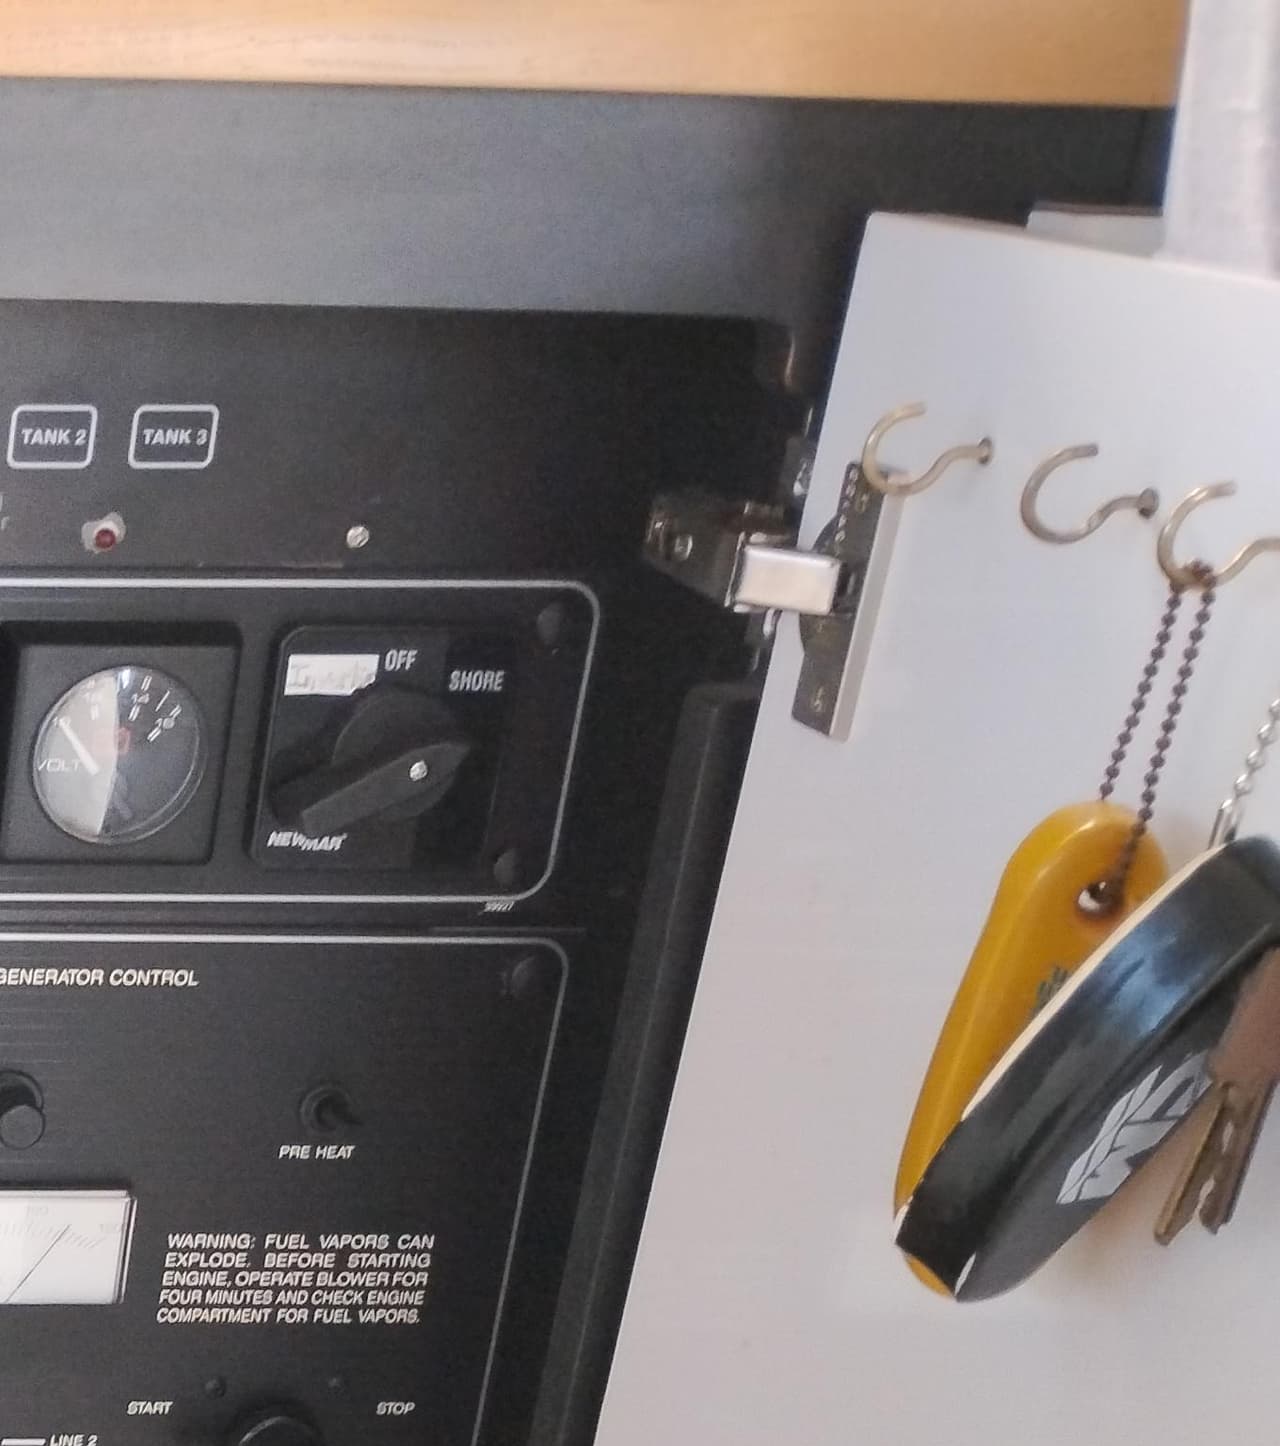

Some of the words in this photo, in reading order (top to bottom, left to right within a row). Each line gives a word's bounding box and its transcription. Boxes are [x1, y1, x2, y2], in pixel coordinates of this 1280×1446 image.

[23, 428, 70, 445] TANK
[74, 428, 88, 446] 2
[143, 428, 190, 445] TANK
[196, 429, 209, 447] 3
[385, 650, 417, 671] OFF
[449, 670, 504, 691] SHORE
[267, 830, 342, 852] NEWMAR
[110, 969, 198, 986] CONTROL
[279, 1145, 311, 1159] PRE
[316, 1146, 355, 1159] HEAT
[168, 1234, 255, 1249] WARNING:
[265, 1234, 309, 1249] FUEL
[320, 1235, 389, 1249] VAPORS
[398, 1234, 434, 1249] CAN
[165, 1252, 250, 1267] EXPLODE.
[264, 1253, 335, 1268] BEFORE
[347, 1253, 430, 1268] STARTING
[163, 1271, 231, 1287] ENGINE,
[235, 1271, 314, 1286] OPERATE
[316, 1272, 389, 1286] BLOWER
[392, 1272, 428, 1286] FOR
[159, 1289, 202, 1304] FOUR
[205, 1290, 273, 1305] MINUTES
[275, 1290, 308, 1305] AND
[311, 1290, 364, 1305] CHECK
[367, 1290, 425, 1305] ENGINE
[157, 1308, 272, 1323] COMPARTMENT
[277, 1308, 308, 1323] FOR
[313, 1309, 351, 1323] FUEL
[359, 1309, 419, 1323] VAPORS.
[127, 1401, 173, 1414] START
[377, 1402, 415, 1414] STOP
[50, 1435, 84, 1446] LINE
